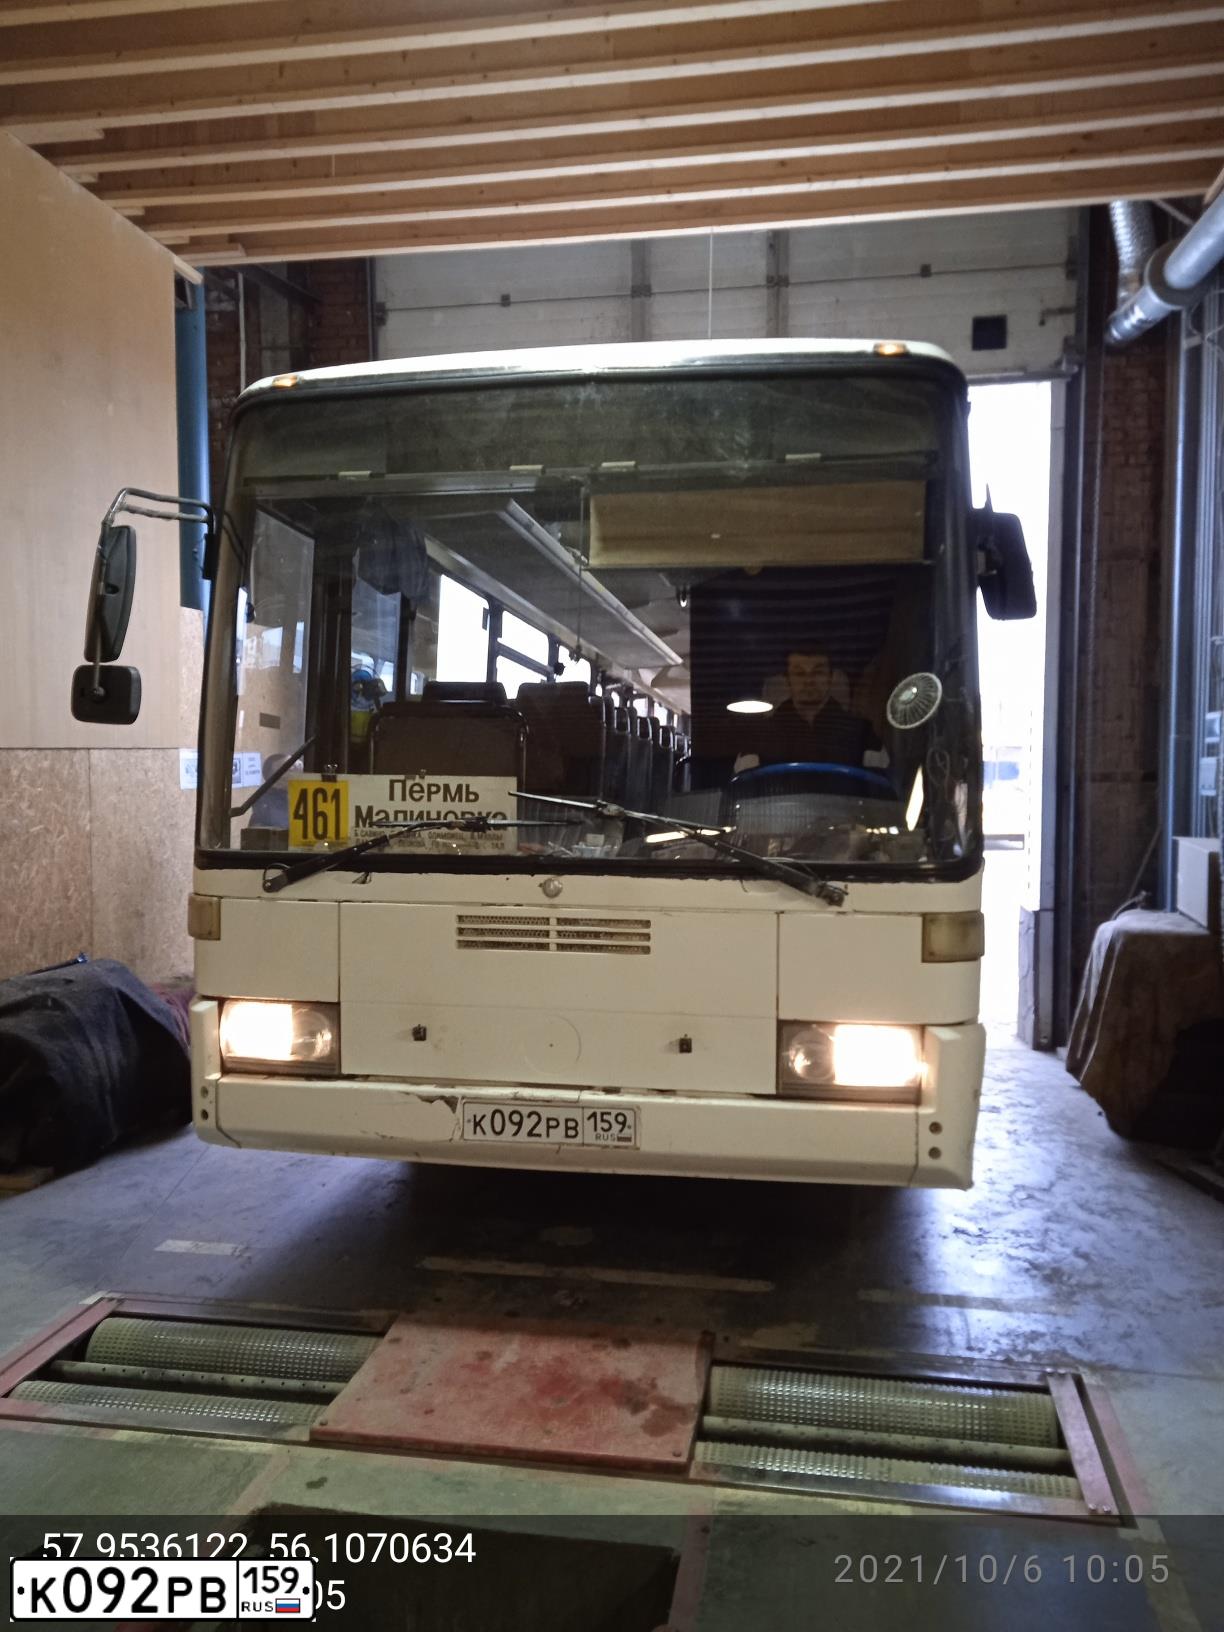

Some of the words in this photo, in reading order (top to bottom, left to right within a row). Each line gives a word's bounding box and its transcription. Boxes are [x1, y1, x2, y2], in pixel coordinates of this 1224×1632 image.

[388, 779, 480, 803] Пермь
[293, 788, 341, 840] 461
[586, 1111, 628, 1133] 159
[595, 1133, 616, 1142] RUS
